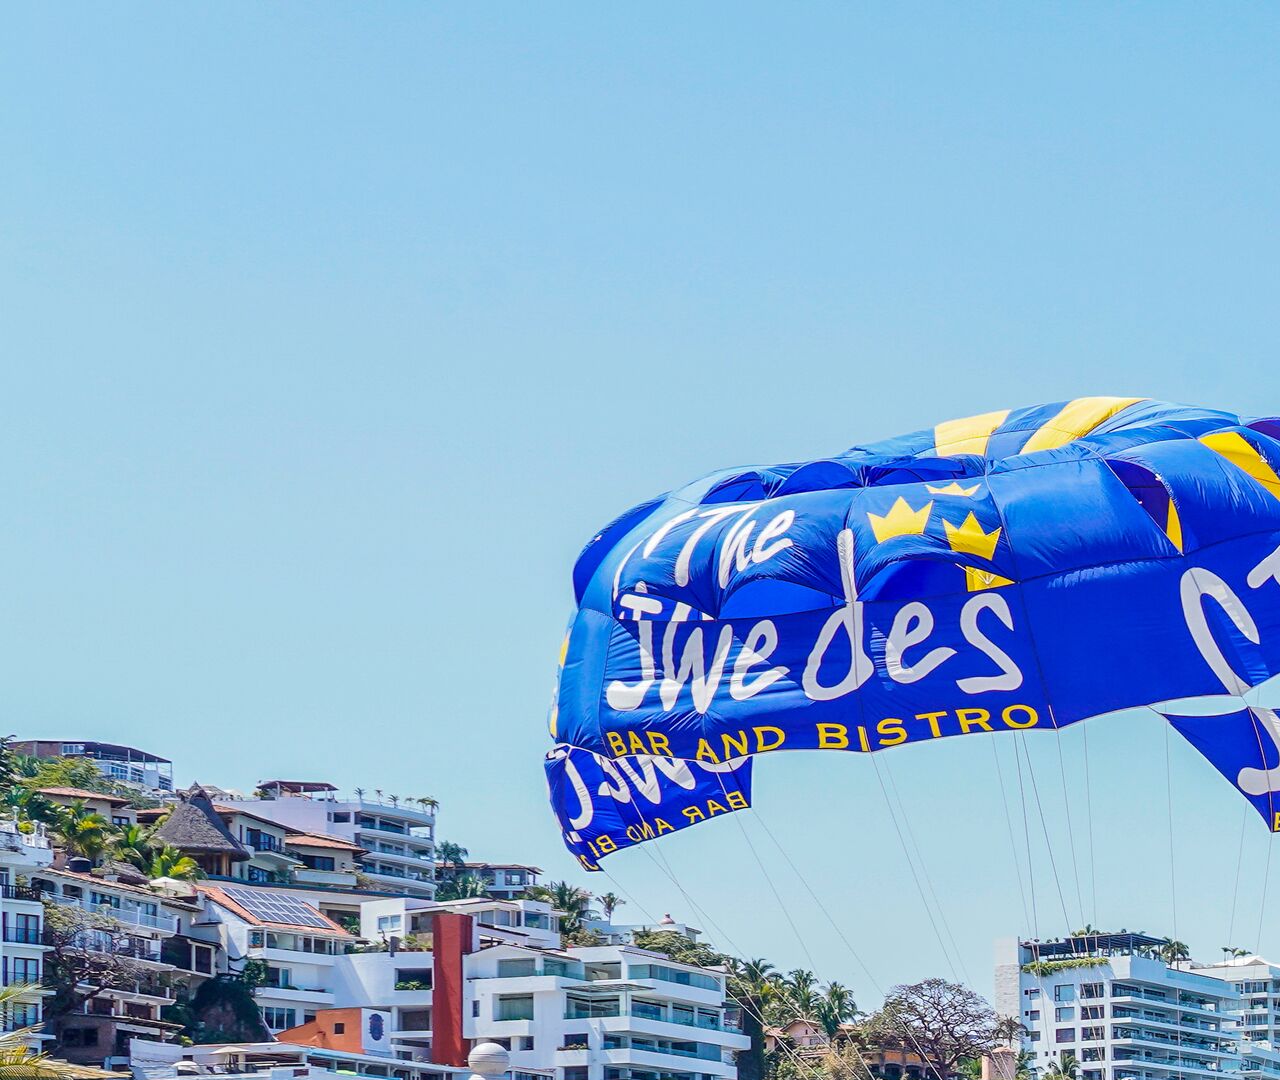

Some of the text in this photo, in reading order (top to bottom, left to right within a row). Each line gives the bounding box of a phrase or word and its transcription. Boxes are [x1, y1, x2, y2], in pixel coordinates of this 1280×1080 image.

[674, 500, 796, 590] The
[607, 704, 1039, 764] BAR AND BISTRO
